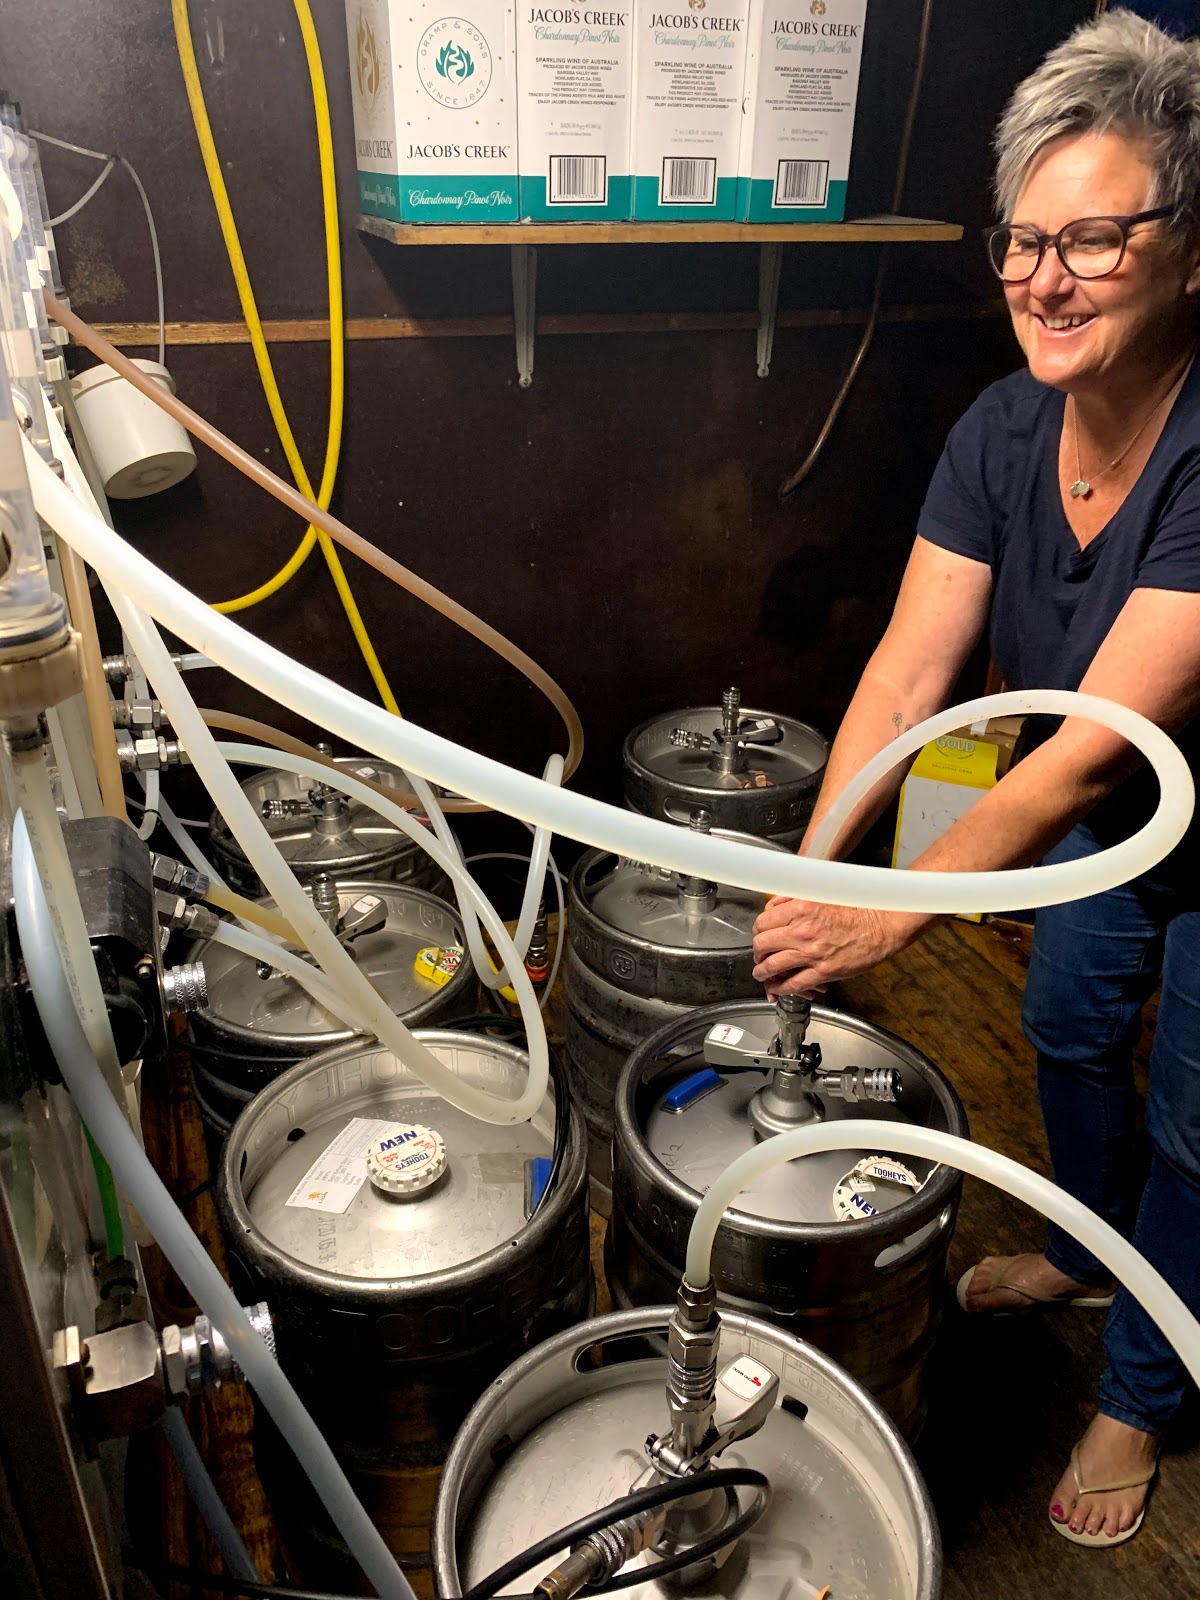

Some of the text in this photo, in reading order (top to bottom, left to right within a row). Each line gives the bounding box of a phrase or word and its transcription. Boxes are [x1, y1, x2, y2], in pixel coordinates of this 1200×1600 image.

[528, 8, 625, 26] JACOB'S CREEK
[649, 14, 740, 32] JACOB'S CREEK
[534, 26, 620, 46] Chardonnay Pinot Noir
[771, 20, 857, 38] JACOB'S CREEK
[421, 21, 488, 58] GRAMP & SONS
[427, 80, 484, 105] SINCE 1847
[407, 144, 507, 158] JACOB'S CREEK
[408, 190, 463, 208] Chardonnay
[464, 190, 489, 206] Pinot
[490, 191, 512, 206] Noir
[936, 735, 975, 752] GOLD
[380, 1130, 418, 1152] NEW
[395, 1152, 430, 1170] TOOHEYS
[874, 1166, 906, 1182] TOOHEYS
